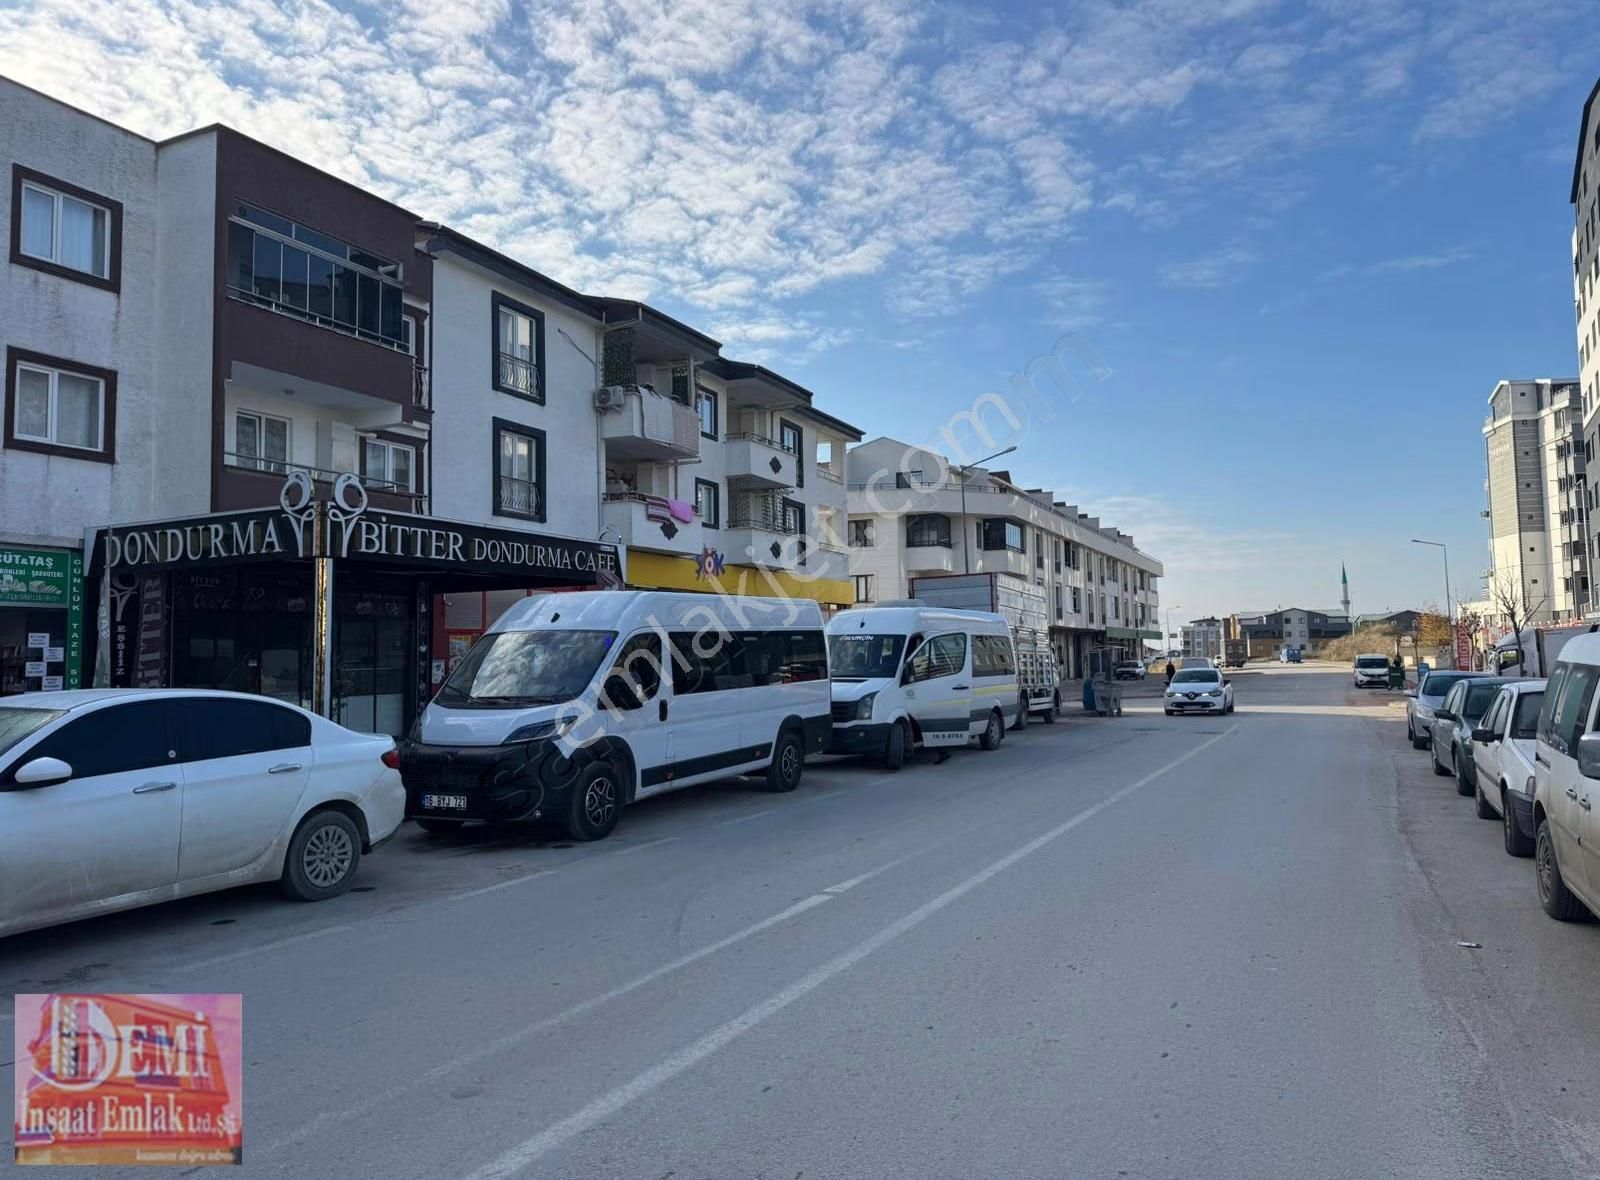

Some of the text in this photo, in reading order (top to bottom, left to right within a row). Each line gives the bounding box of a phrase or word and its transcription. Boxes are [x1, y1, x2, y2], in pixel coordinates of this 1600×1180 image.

[0, 551, 54, 569] ÜT&TAŞ
[103, 517, 282, 569] DONDURMA
[358, 516, 617, 573] BİTTER DONDURMA CAFE
[70, 559, 82, 690] GÜNLÜK TAZE SÜ
